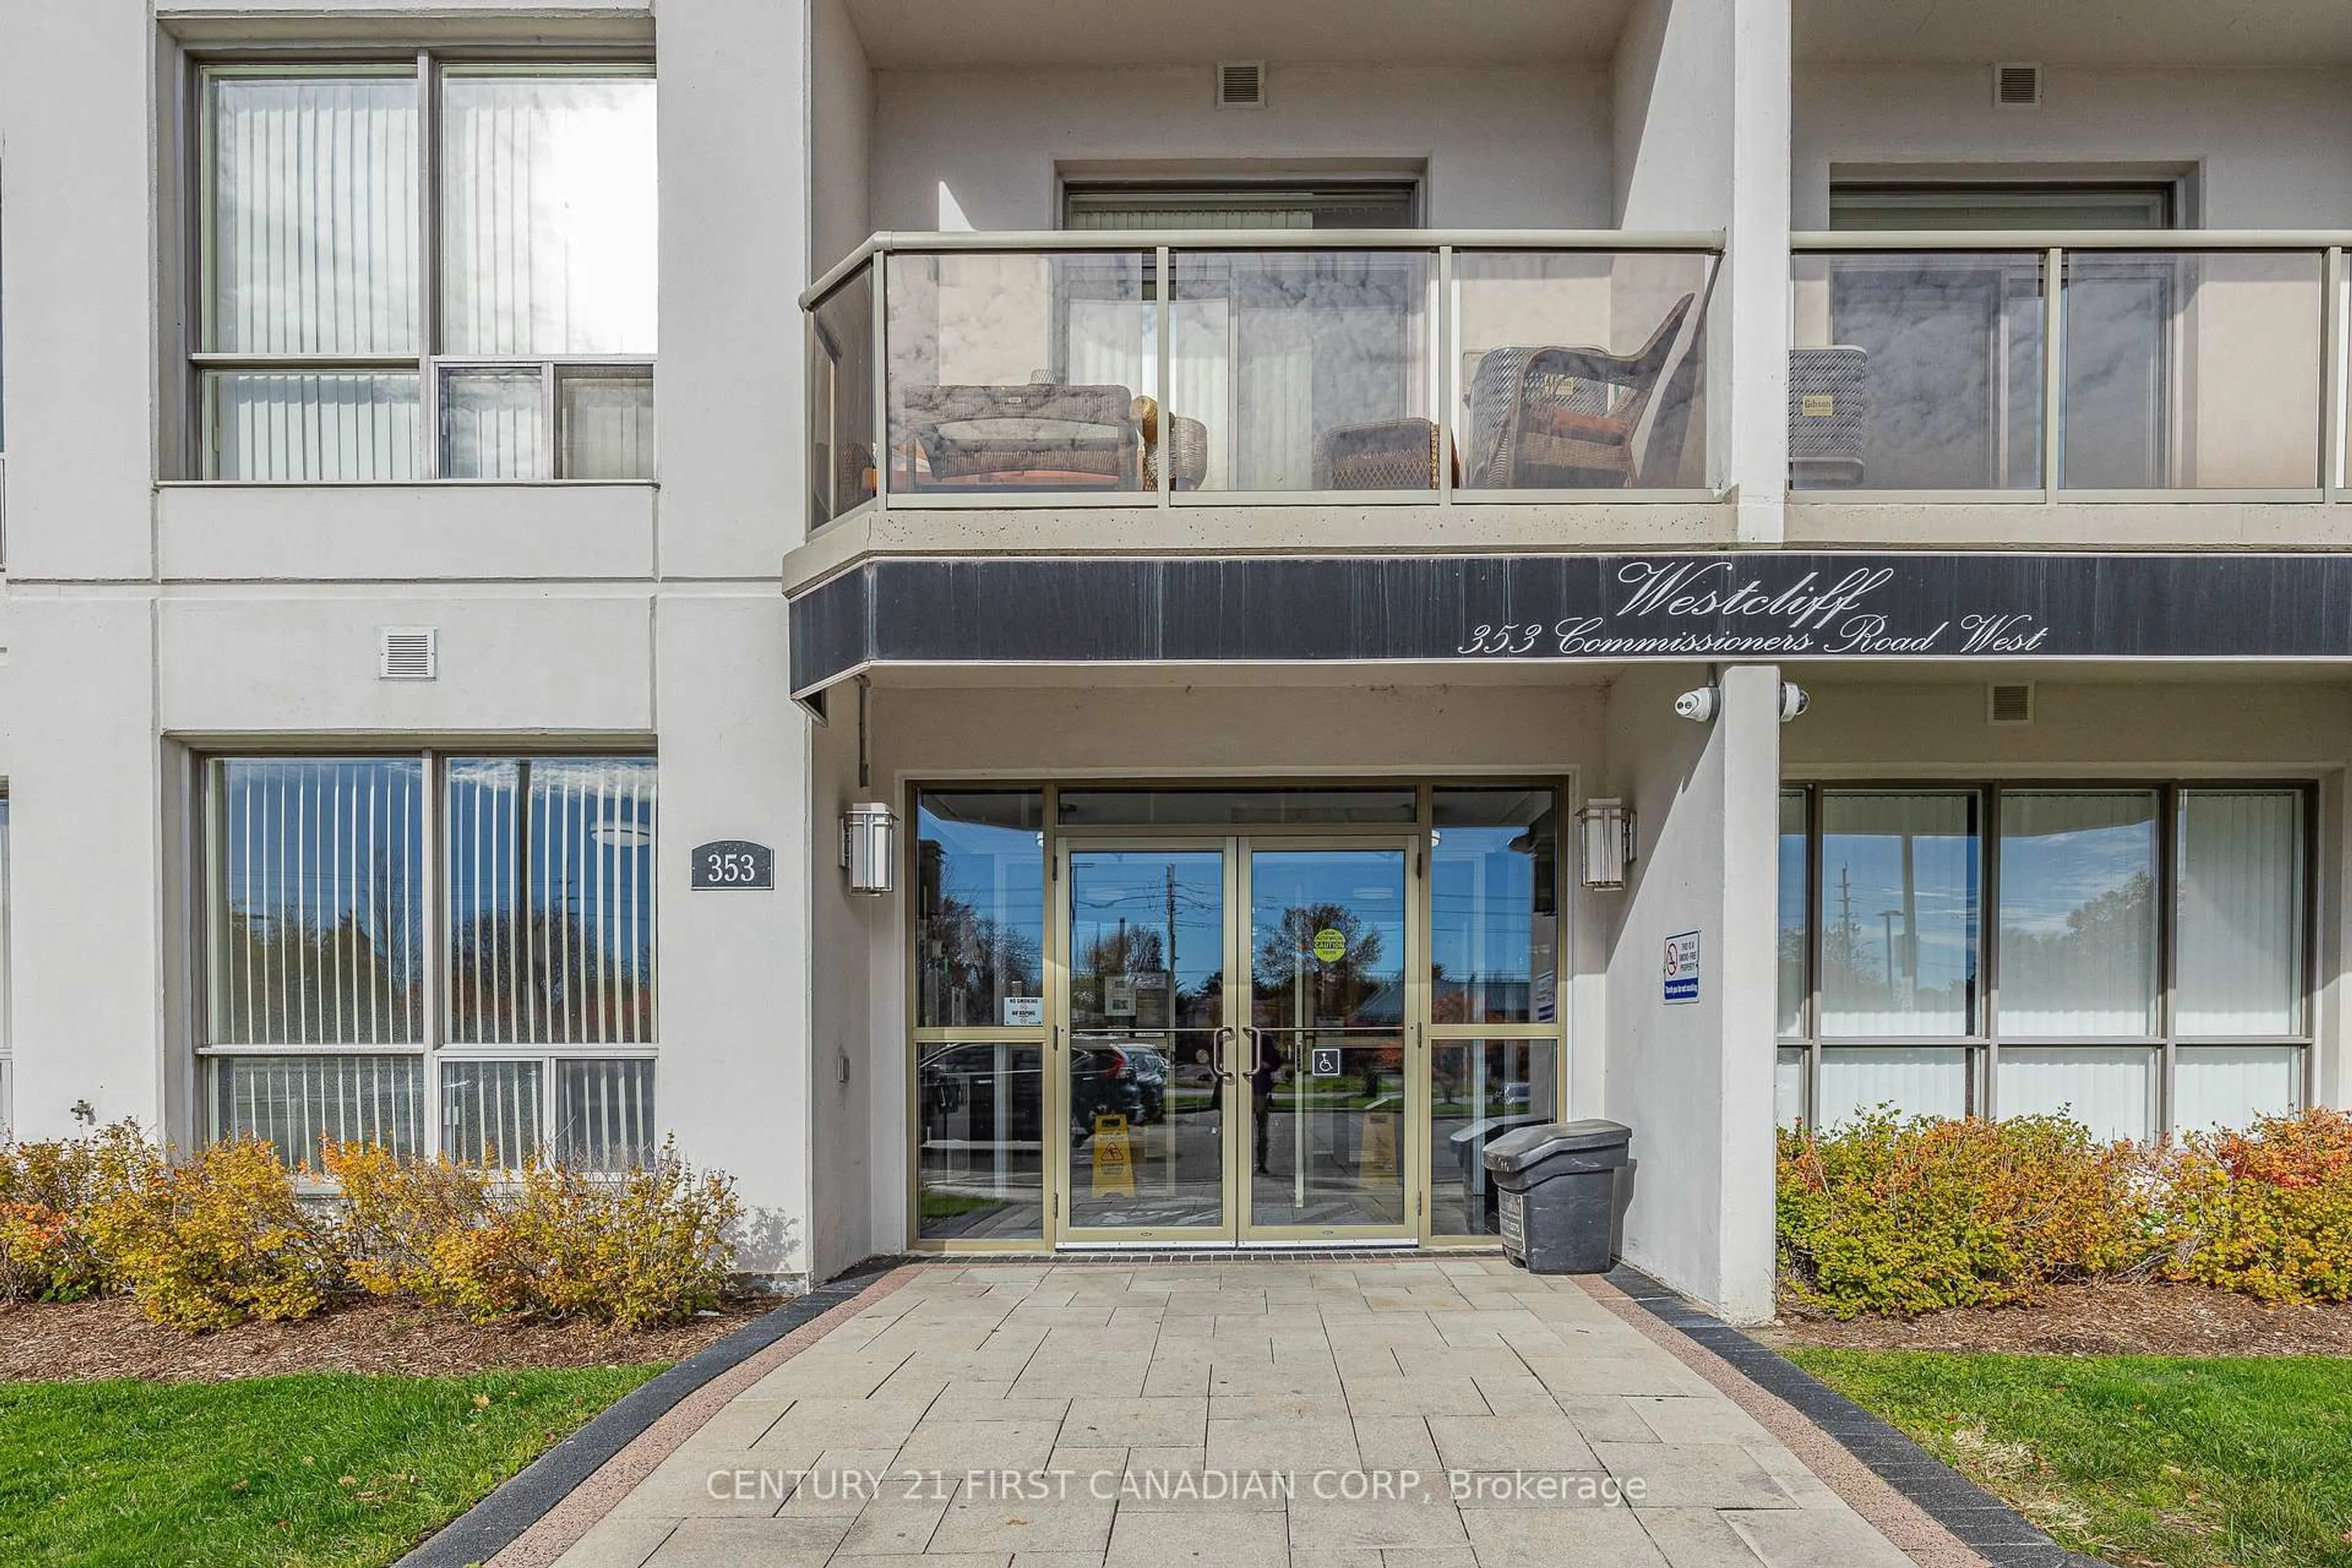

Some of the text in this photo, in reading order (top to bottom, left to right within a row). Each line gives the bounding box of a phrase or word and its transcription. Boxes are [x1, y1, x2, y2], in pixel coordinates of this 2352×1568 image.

[1616, 562, 1894, 629] Westcliff
[1457, 614, 2049, 654] 353 Commissioners Road West
[708, 854, 755, 882] 353
